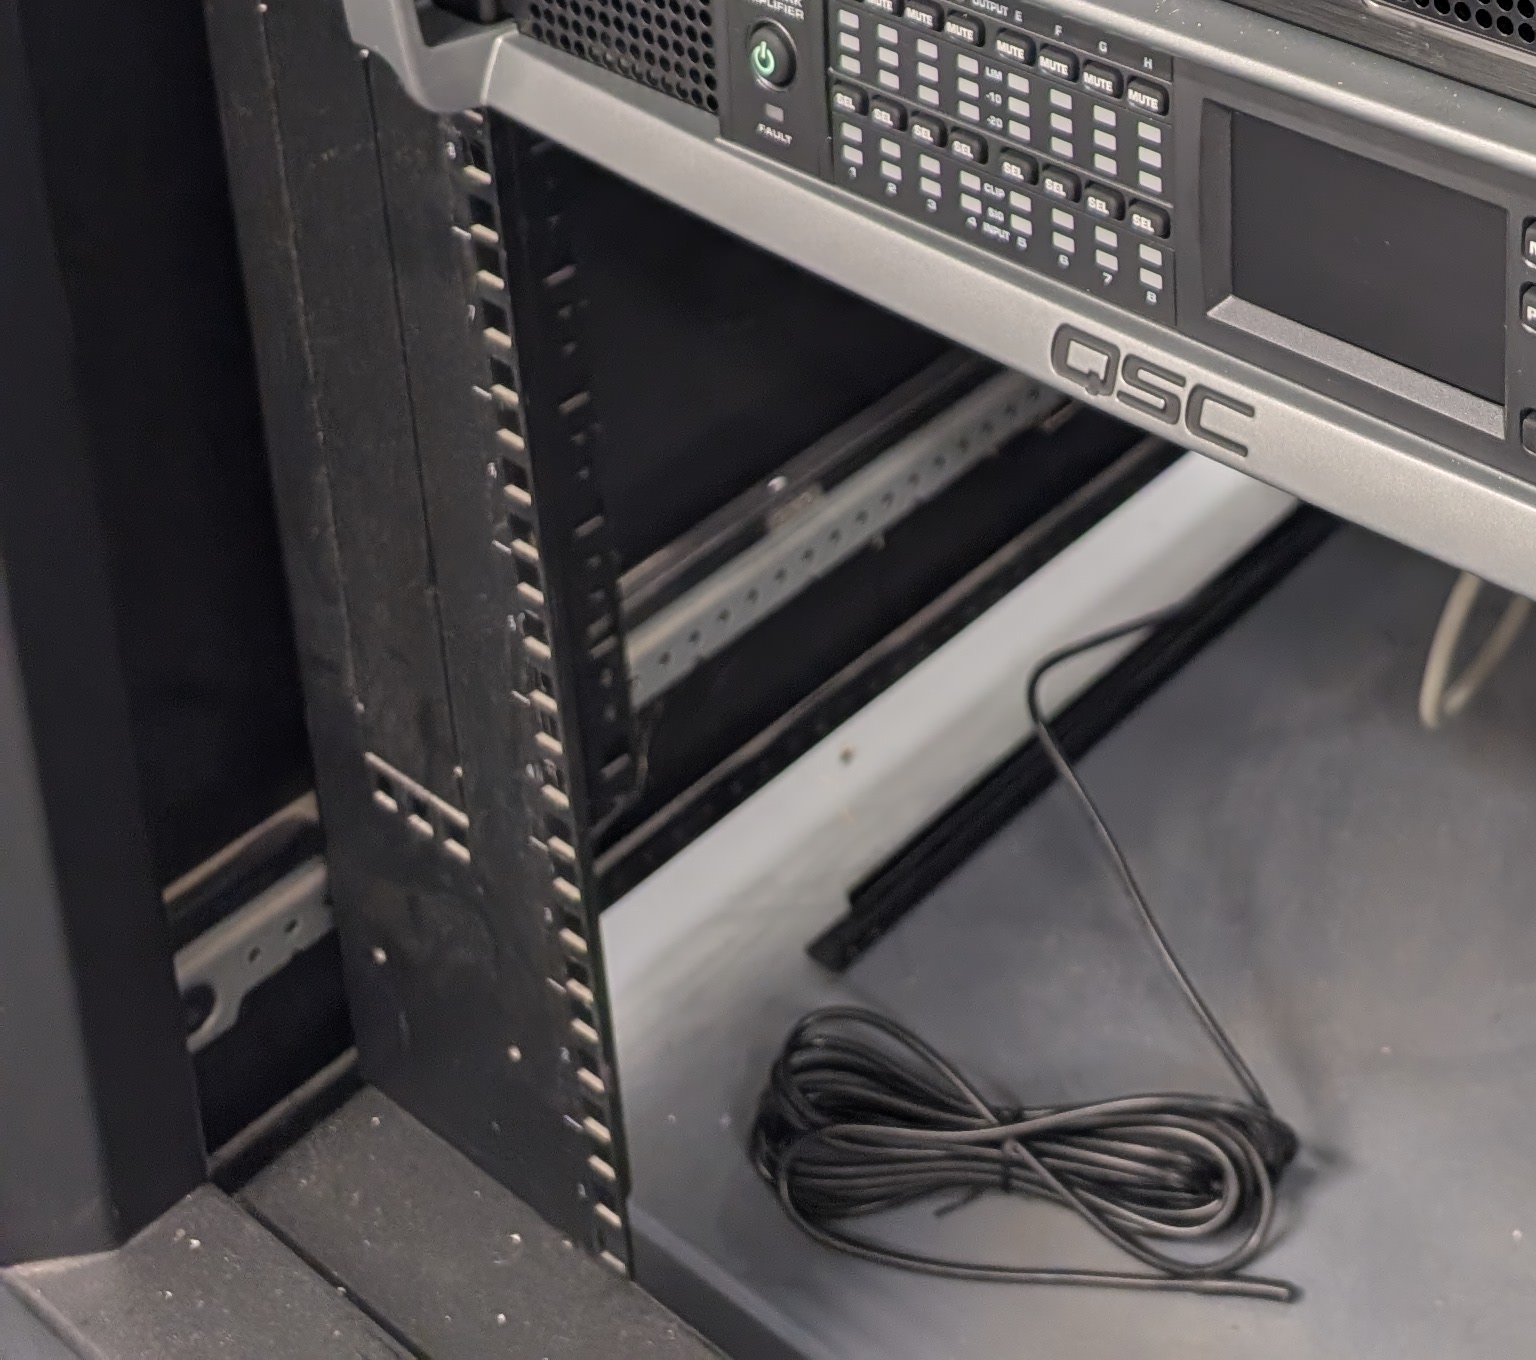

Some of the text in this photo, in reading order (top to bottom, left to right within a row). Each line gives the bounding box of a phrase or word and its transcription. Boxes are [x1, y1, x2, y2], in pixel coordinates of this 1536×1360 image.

[906, 7, 933, 27] MUTE
[1015, 10, 1022, 22] E
[947, 22, 974, 41] MUTE
[1055, 25, 1062, 37] F
[997, 40, 1025, 61] MUTE
[1099, 41, 1107, 54] G
[1039, 56, 1068, 76] MUTE
[1144, 57, 1153, 70] H
[1084, 71, 1113, 92] MUTE
[834, 92, 855, 110] SEL
[985, 91, 1002, 105] -10
[1128, 88, 1158, 111] MUTE
[872, 108, 893, 126] SEL
[758, 123, 793, 145] FAULT
[913, 124, 934, 142] SEL
[952, 140, 974, 159] SEL
[1002, 161, 1024, 180] SEL
[984, 182, 1005, 199] CLIP
[1044, 178, 1066, 197] SEL
[927, 199, 937, 212] 3
[1088, 195, 1109, 215] SEL
[966, 216, 977, 228] 4
[1132, 213, 1155, 233] SEL
[982, 222, 1010, 242] INPUT
[1059, 254, 1069, 268] 6
[1102, 272, 1112, 285] 7
[1051, 323, 1255, 458] QSC
